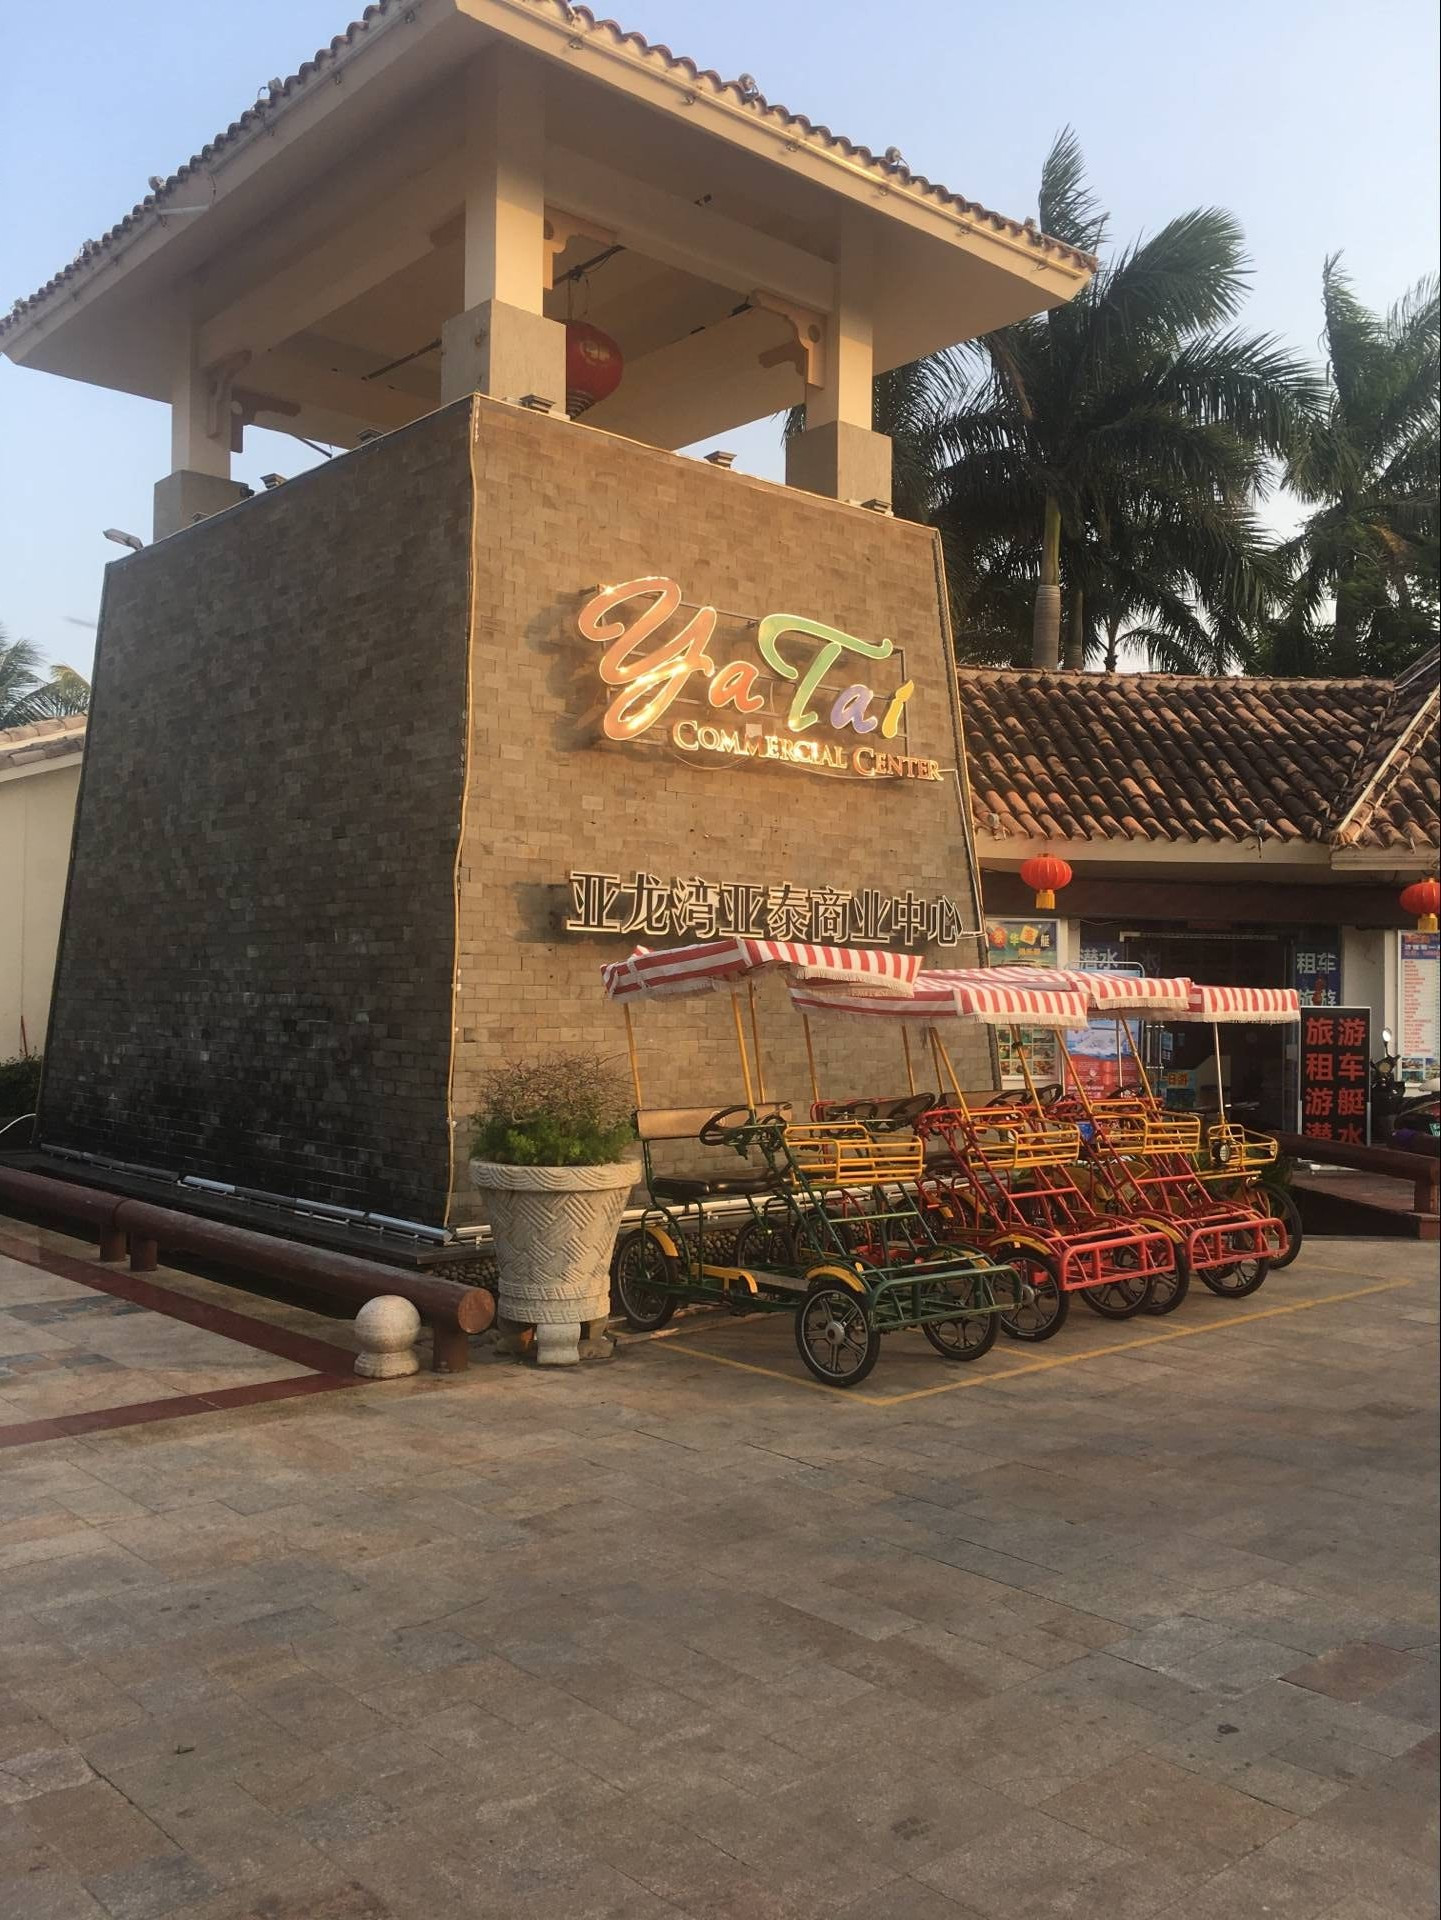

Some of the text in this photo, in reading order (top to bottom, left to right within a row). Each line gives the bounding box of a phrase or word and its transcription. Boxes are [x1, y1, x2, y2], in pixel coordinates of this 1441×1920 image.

[566, 871, 964, 947] 亚龙湾亚泰商业中心
[1306, 1018, 1365, 1046] 旅游
[1306, 1053, 1365, 1081] 租车
[1305, 1088, 1365, 1115] 游艇
